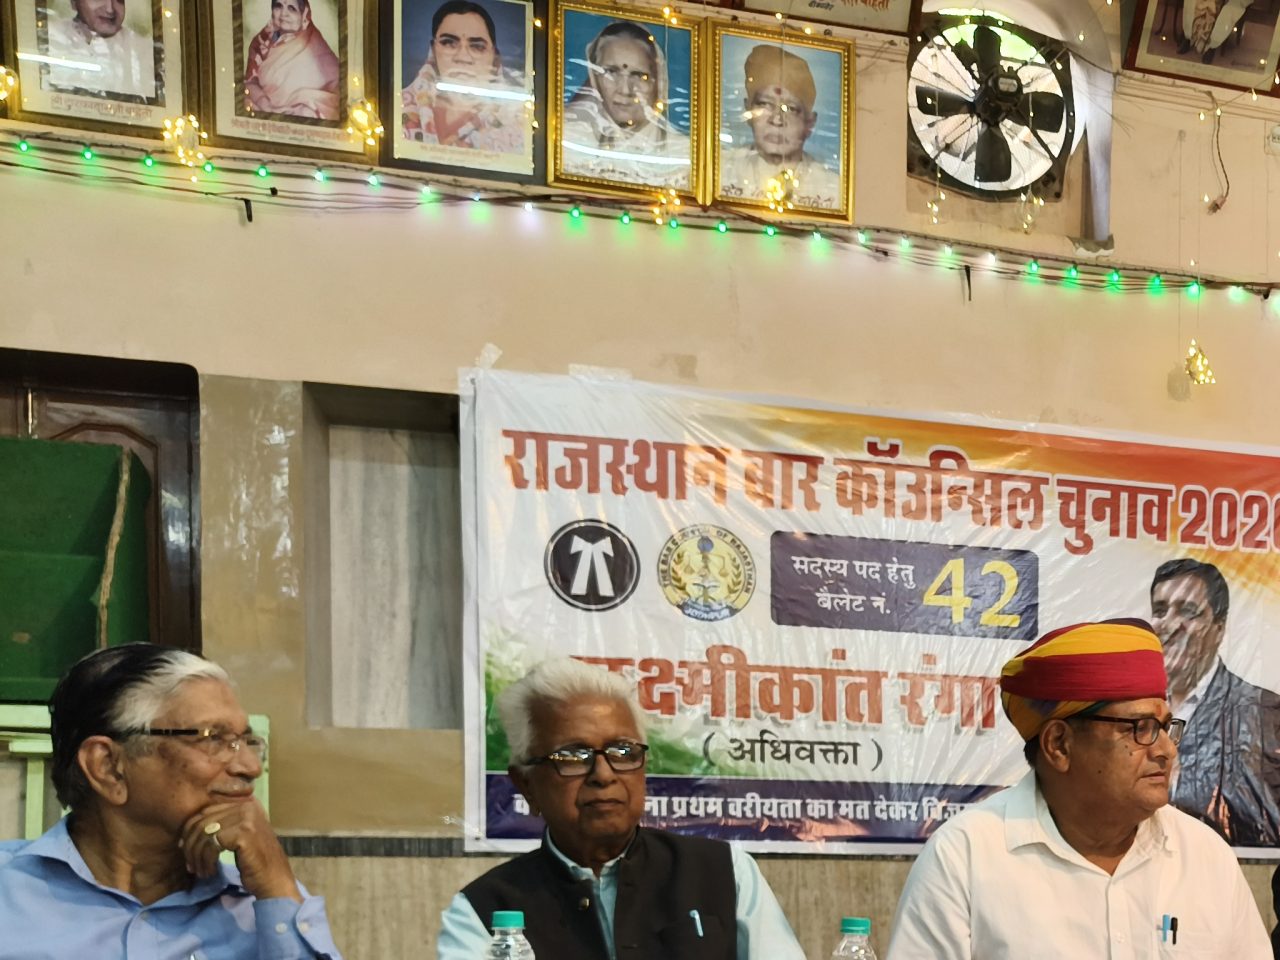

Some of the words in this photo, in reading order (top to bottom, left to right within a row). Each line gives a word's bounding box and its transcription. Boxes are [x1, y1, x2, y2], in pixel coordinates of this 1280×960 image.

[502, 429, 727, 505] राजस्थान
[741, 448, 825, 511] बार
[1056, 479, 1174, 553] चुनाव
[791, 555, 848, 578] सदस्य
[853, 560, 881, 583] पद
[922, 557, 1021, 628] 42
[815, 586, 866, 612] बैलेट
[898, 653, 1001, 728] रंगा
[671, 795, 724, 819] प्रथम
[728, 792, 801, 818] वरीयता
[805, 797, 835, 818] का
[838, 799, 871, 820] मत
[874, 795, 918, 822] देकर
